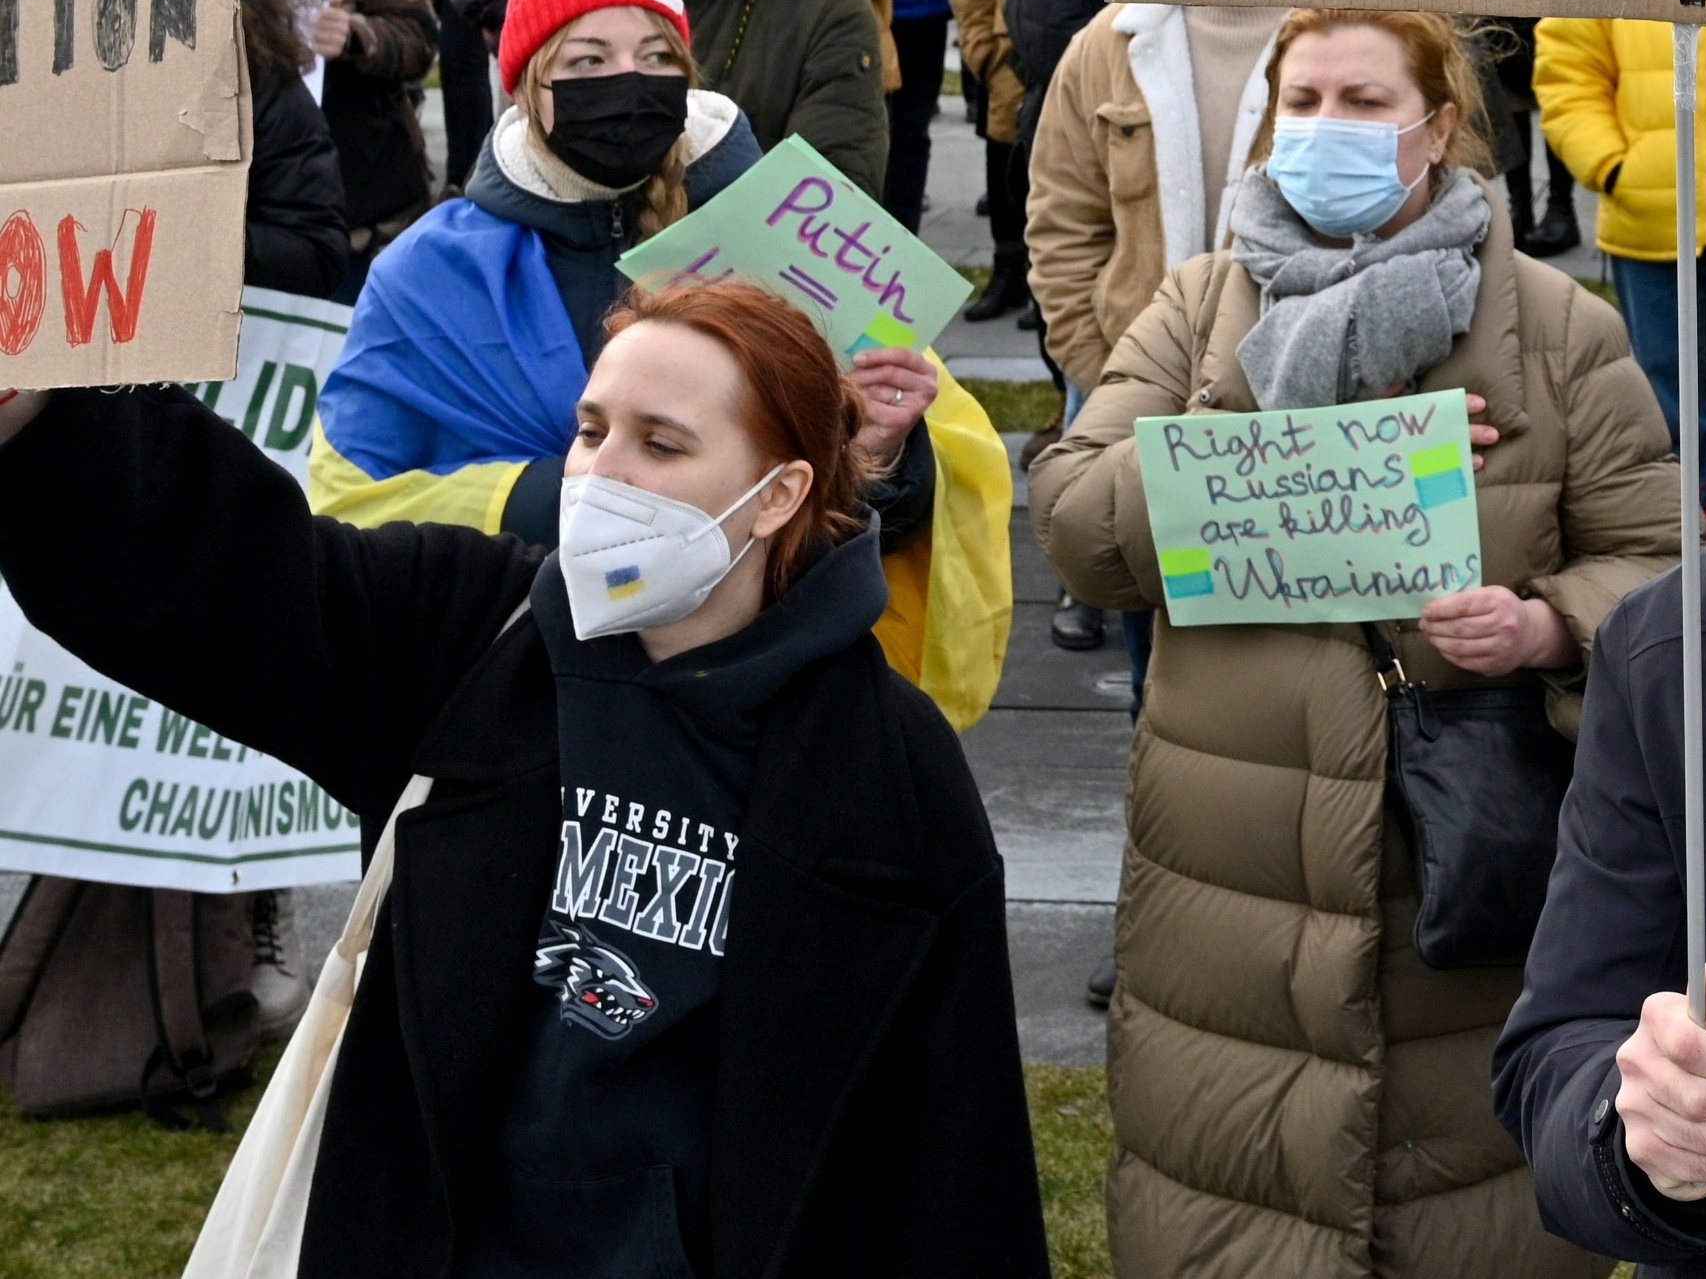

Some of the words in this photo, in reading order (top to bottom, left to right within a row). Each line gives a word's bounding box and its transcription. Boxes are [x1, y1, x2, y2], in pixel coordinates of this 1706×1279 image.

[0, 206, 156, 355] OW
[765, 177, 913, 324] Putin
[1163, 414, 1315, 477] Right
[1338, 403, 1437, 451] now
[1207, 453, 1405, 505] Russians
[1200, 518, 1268, 546] are
[1280, 497, 1430, 548] killing
[1213, 547, 1478, 608] Ukrainians
[50, 685, 150, 749] EINE
[561, 786, 740, 861] VERSITY
